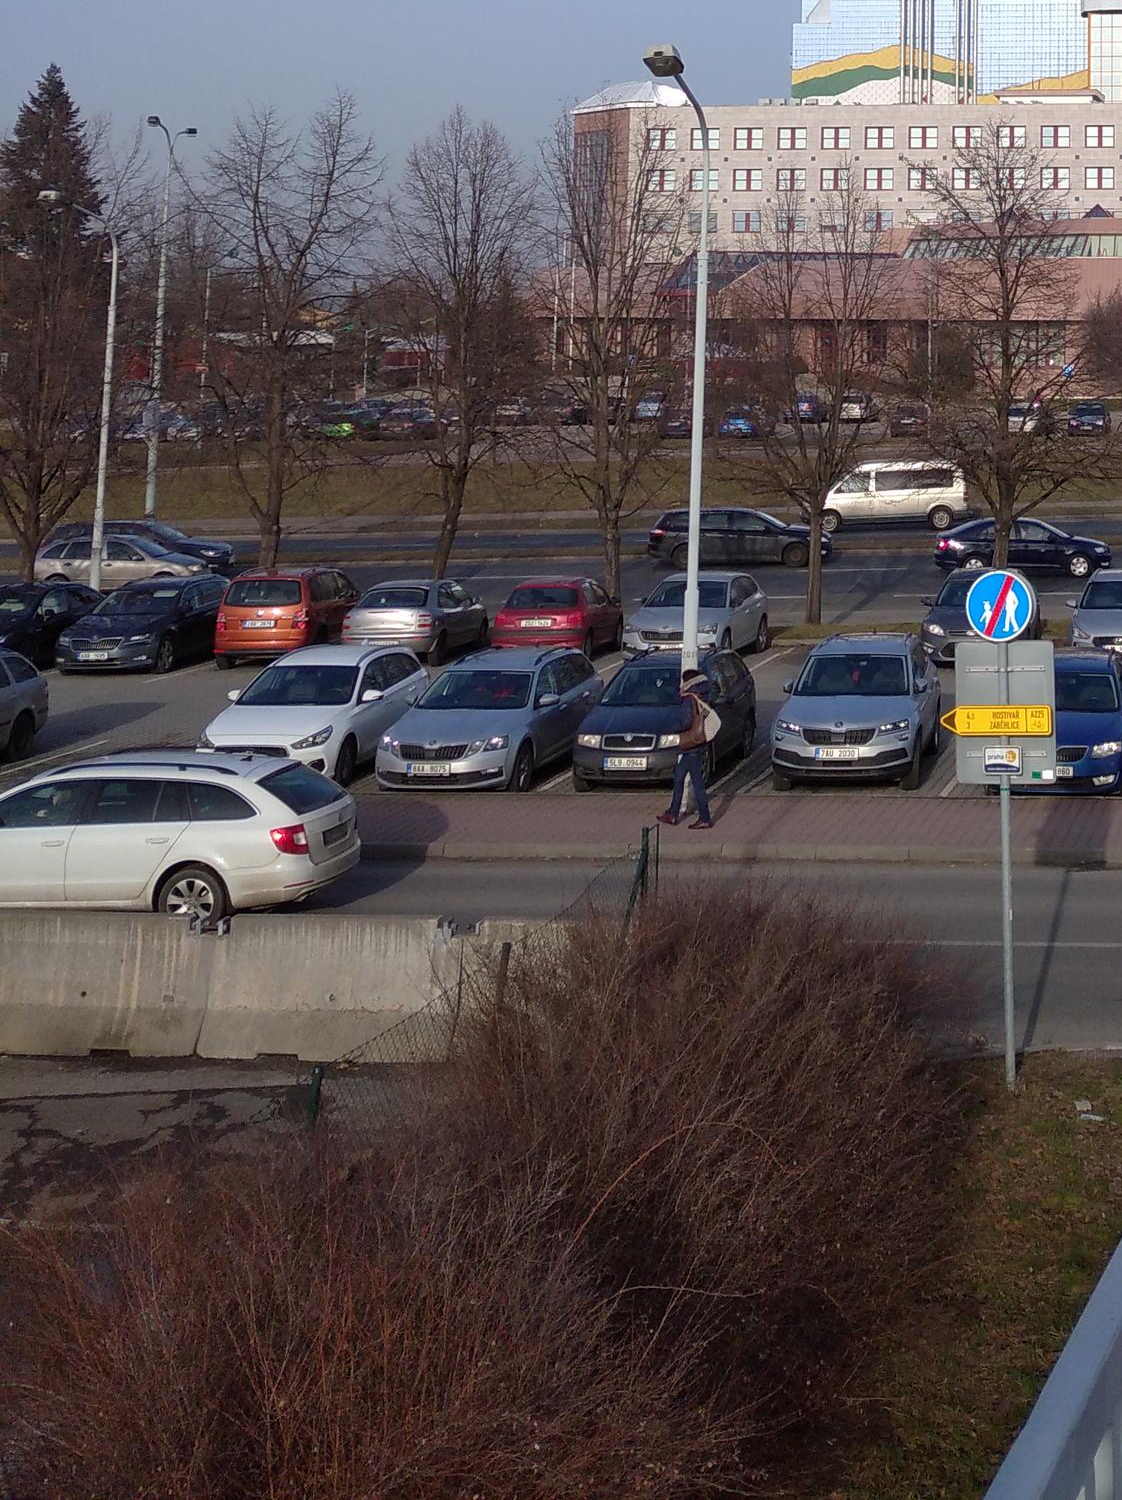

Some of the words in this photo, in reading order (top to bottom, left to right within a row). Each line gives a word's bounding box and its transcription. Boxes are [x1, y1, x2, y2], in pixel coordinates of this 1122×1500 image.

[992, 709, 1020, 719] HOSTIVAŘ
[1030, 710, 1045, 718] A225
[987, 753, 1004, 761] praha
[609, 759, 622, 767] 5L9
[626, 759, 644, 767] 0944
[430, 763, 447, 772] 8075
